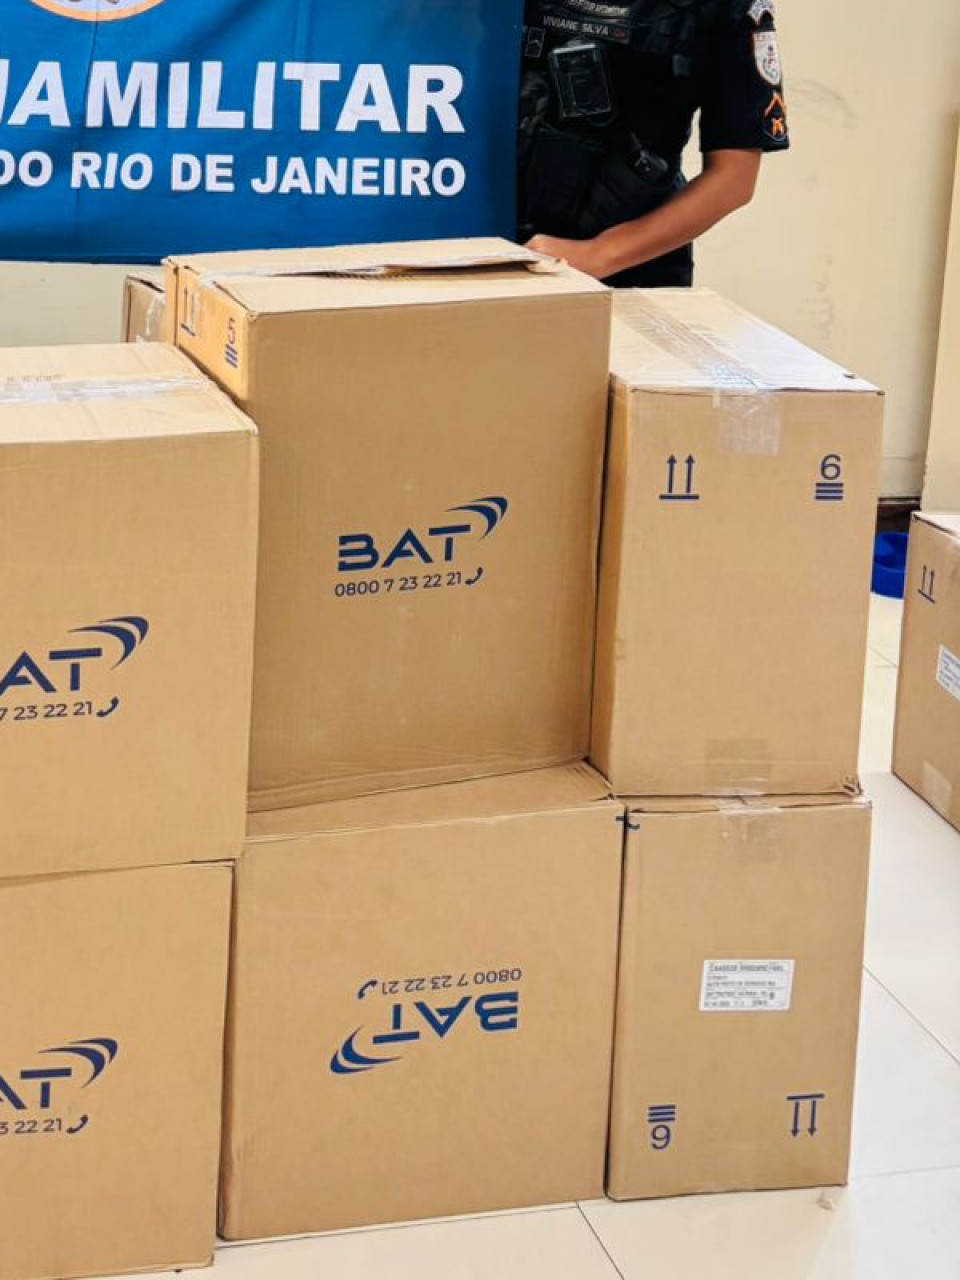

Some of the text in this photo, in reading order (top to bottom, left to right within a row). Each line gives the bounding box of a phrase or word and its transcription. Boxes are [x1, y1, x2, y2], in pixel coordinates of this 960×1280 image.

[581, 23, 609, 37] SILVA
[86, 61, 466, 133] MILITAR
[71, 151, 153, 190] RIO
[171, 153, 234, 192] DE
[251, 156, 467, 196] JANEIRO
[820, 453, 842, 481] 6
[337, 523, 471, 572] BAT
[333, 571, 462, 597] 0800 7 23 22 21
[13, 705, 38, 721] 23
[43, 703, 68, 718] 22
[72, 701, 93, 715] 21
[404, 977, 425, 993] 22
[431, 975, 452, 990] 23
[473, 967, 522, 985] 0800
[381, 980, 399, 995] 21
[372, 991, 519, 1045] BAT
[14, 1119, 39, 1134] 22
[42, 1117, 62, 1132] 21
